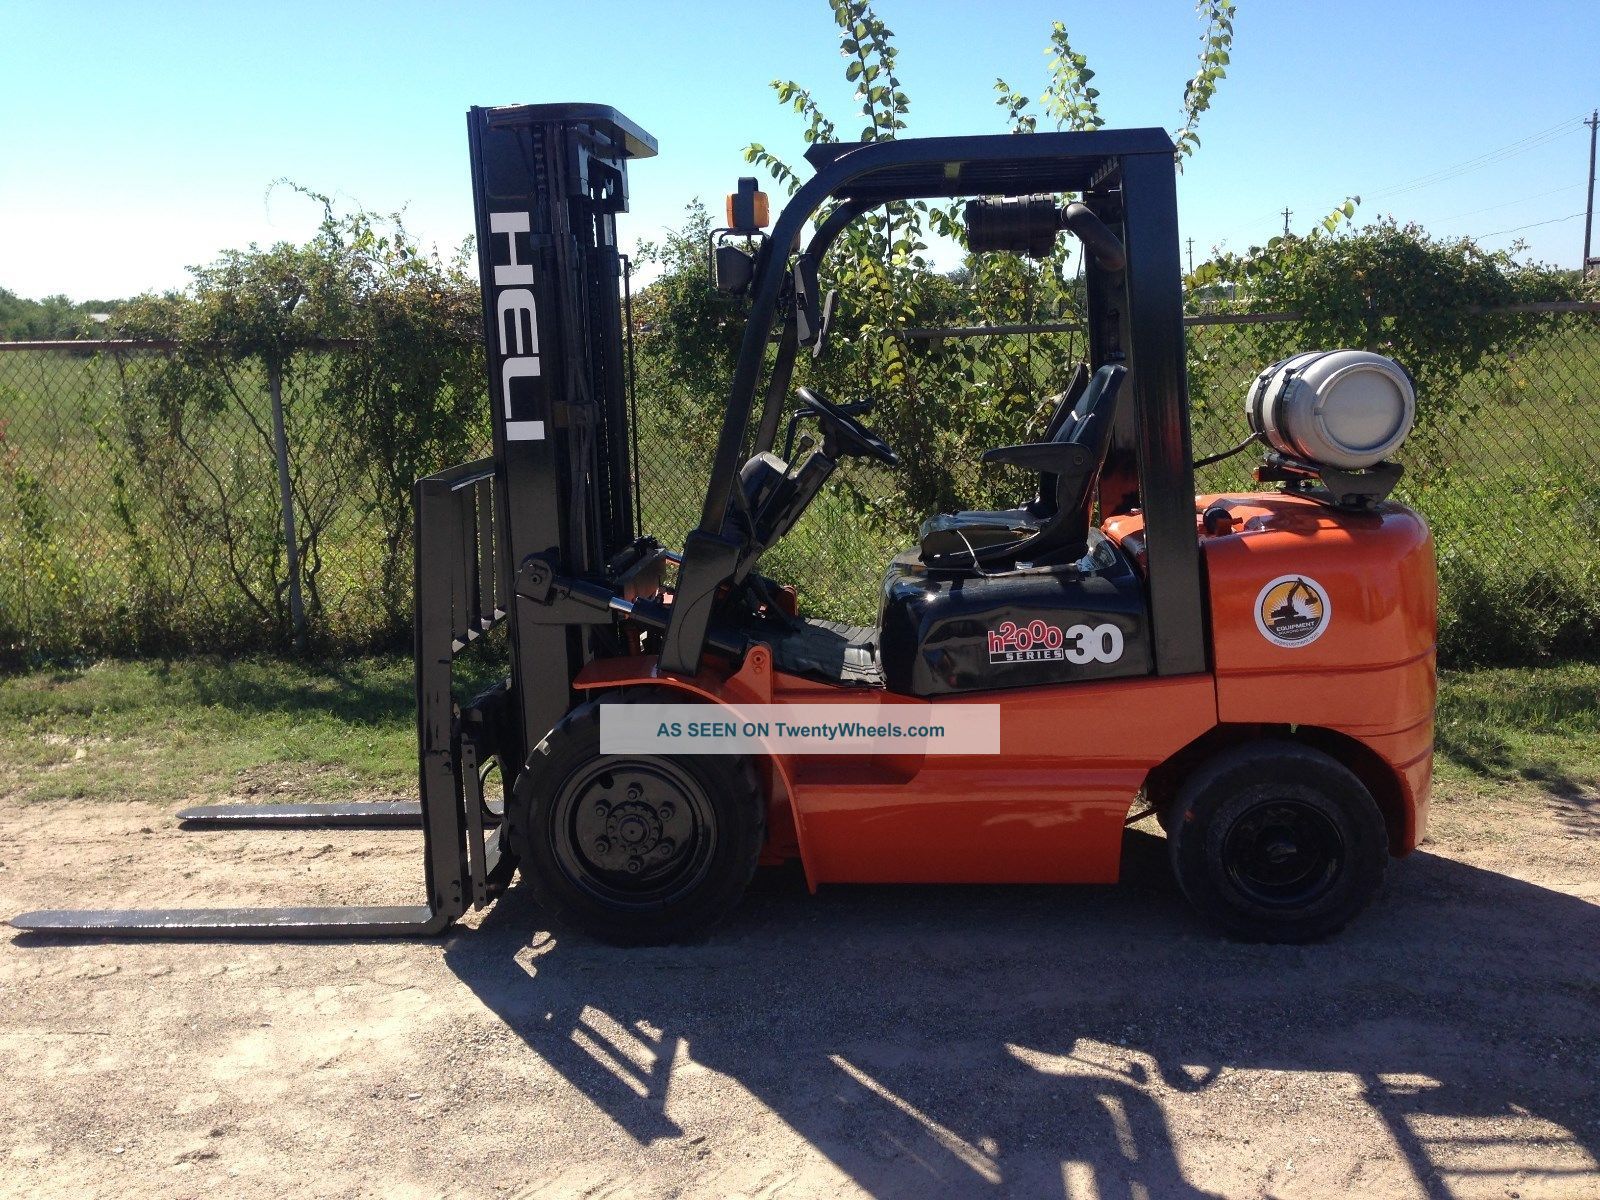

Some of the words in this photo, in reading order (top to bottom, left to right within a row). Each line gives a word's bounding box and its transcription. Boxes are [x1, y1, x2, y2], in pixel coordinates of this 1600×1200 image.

[490, 212, 545, 441] HELI
[988, 620, 1063, 652] h2000
[1276, 621, 1315, 632] EQUIPMENT
[1005, 650, 1062, 661] SERIES
[1065, 623, 1124, 664] 30
